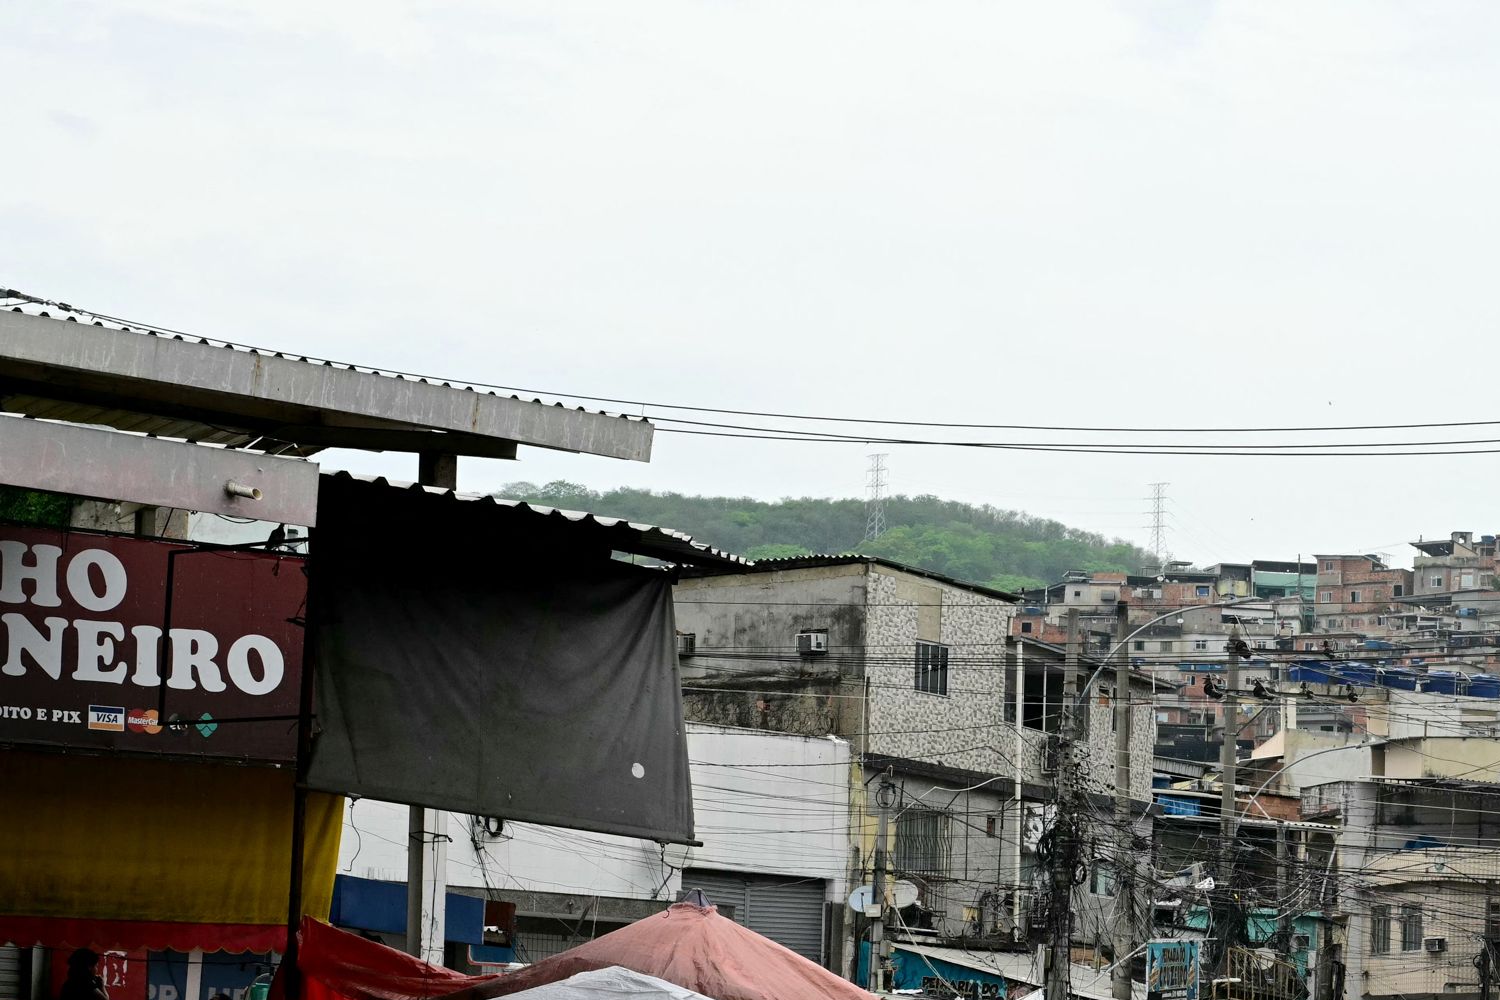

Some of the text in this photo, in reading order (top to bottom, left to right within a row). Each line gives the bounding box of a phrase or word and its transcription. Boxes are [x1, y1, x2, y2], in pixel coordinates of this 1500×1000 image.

[0, 540, 127, 612] HO
[1, 613, 284, 695] NEIRO
[37, 709, 47, 720] E
[52, 709, 81, 723] PIX
[96, 712, 118, 723] VISA
[128, 716, 160, 726] MasterCar
